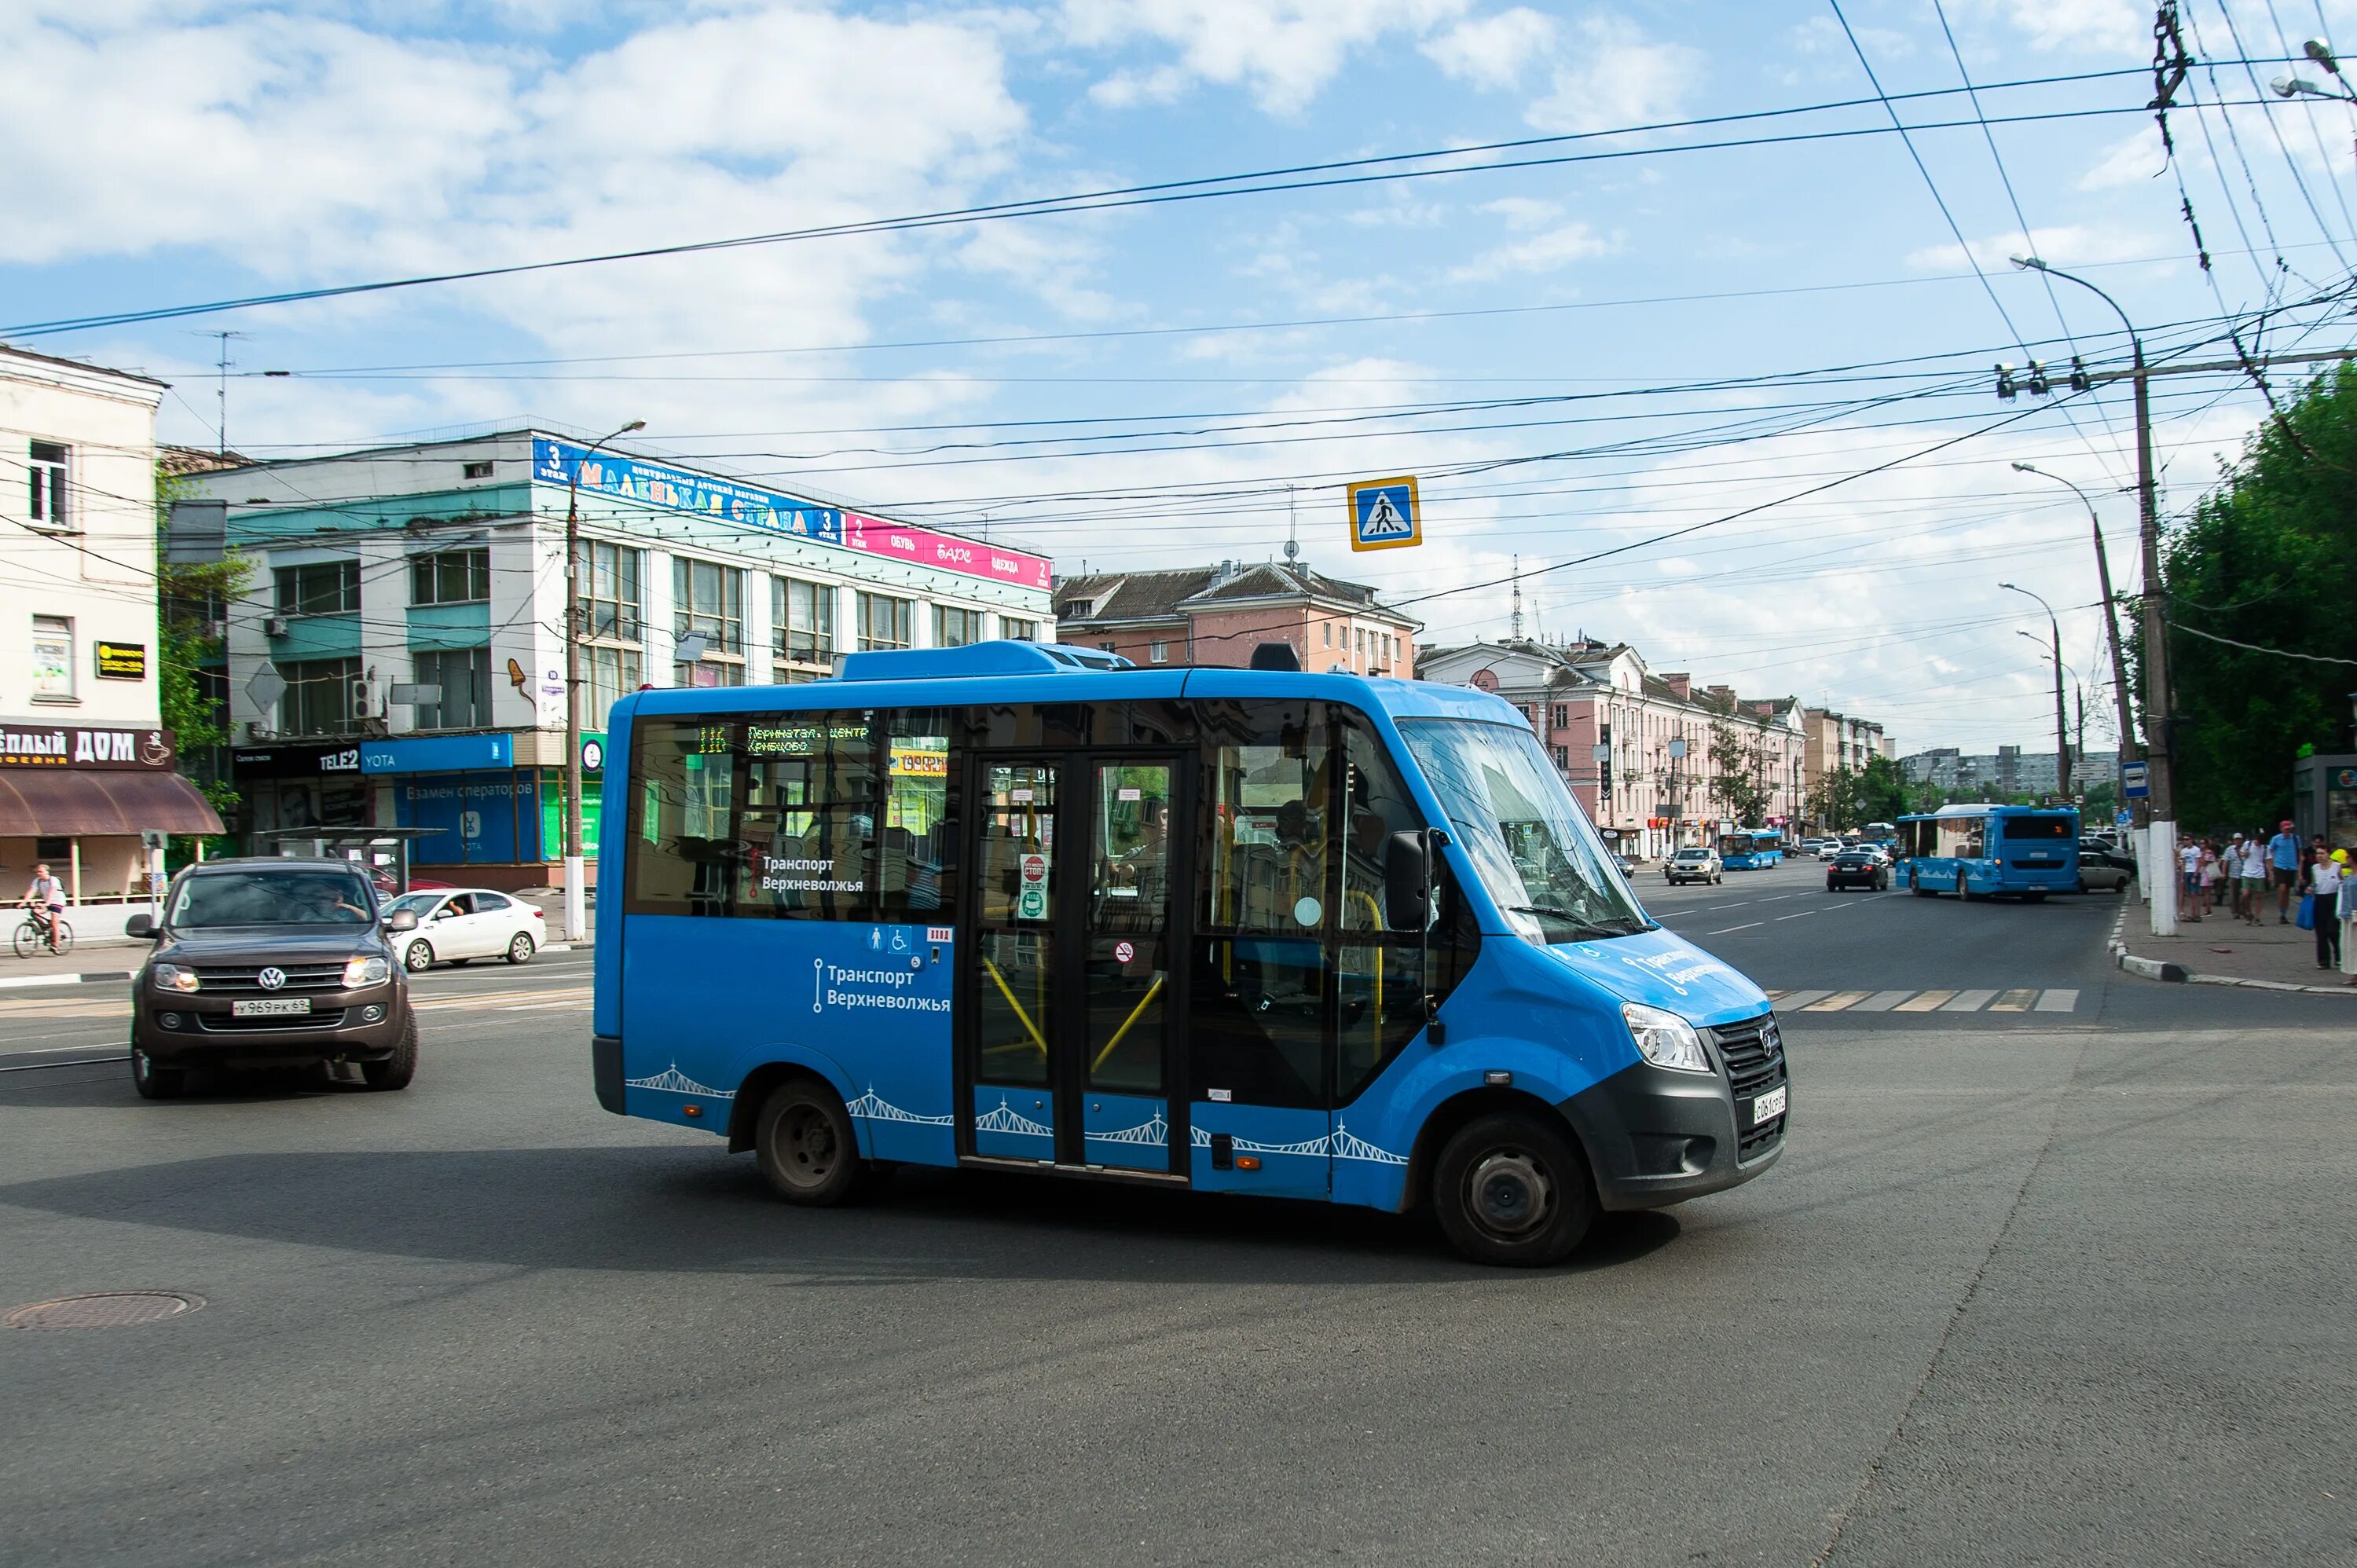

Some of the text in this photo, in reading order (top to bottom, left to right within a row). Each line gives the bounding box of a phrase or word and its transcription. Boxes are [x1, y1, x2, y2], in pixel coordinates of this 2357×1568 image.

[548, 445, 561, 470] 3
[541, 468, 569, 482] этаж
[581, 460, 808, 536] МАЛЕНЬКАЯ СТРАНА
[697, 480, 733, 496] детский
[735, 489, 769, 504] магазин
[823, 511, 831, 532] 3
[855, 518, 863, 538] 2
[890, 534, 915, 551] ОБУВЬ
[992, 556, 1019, 575] ОДЕЖДА
[1039, 562, 1046, 578] 2
[75, 731, 136, 763] ДОМ
[0, 755, 68, 765] ФЕЙНЯ
[320, 749, 359, 771] TELE2
[365, 754, 396, 768] YOTA
[406, 786, 454, 800] Взамен
[763, 855, 834, 874] Транспорт
[762, 876, 863, 894] Верхневолжья
[931, 929, 949, 940] ВХОД
[827, 965, 915, 988] Транспорт
[827, 989, 951, 1012] Верхневолжья
